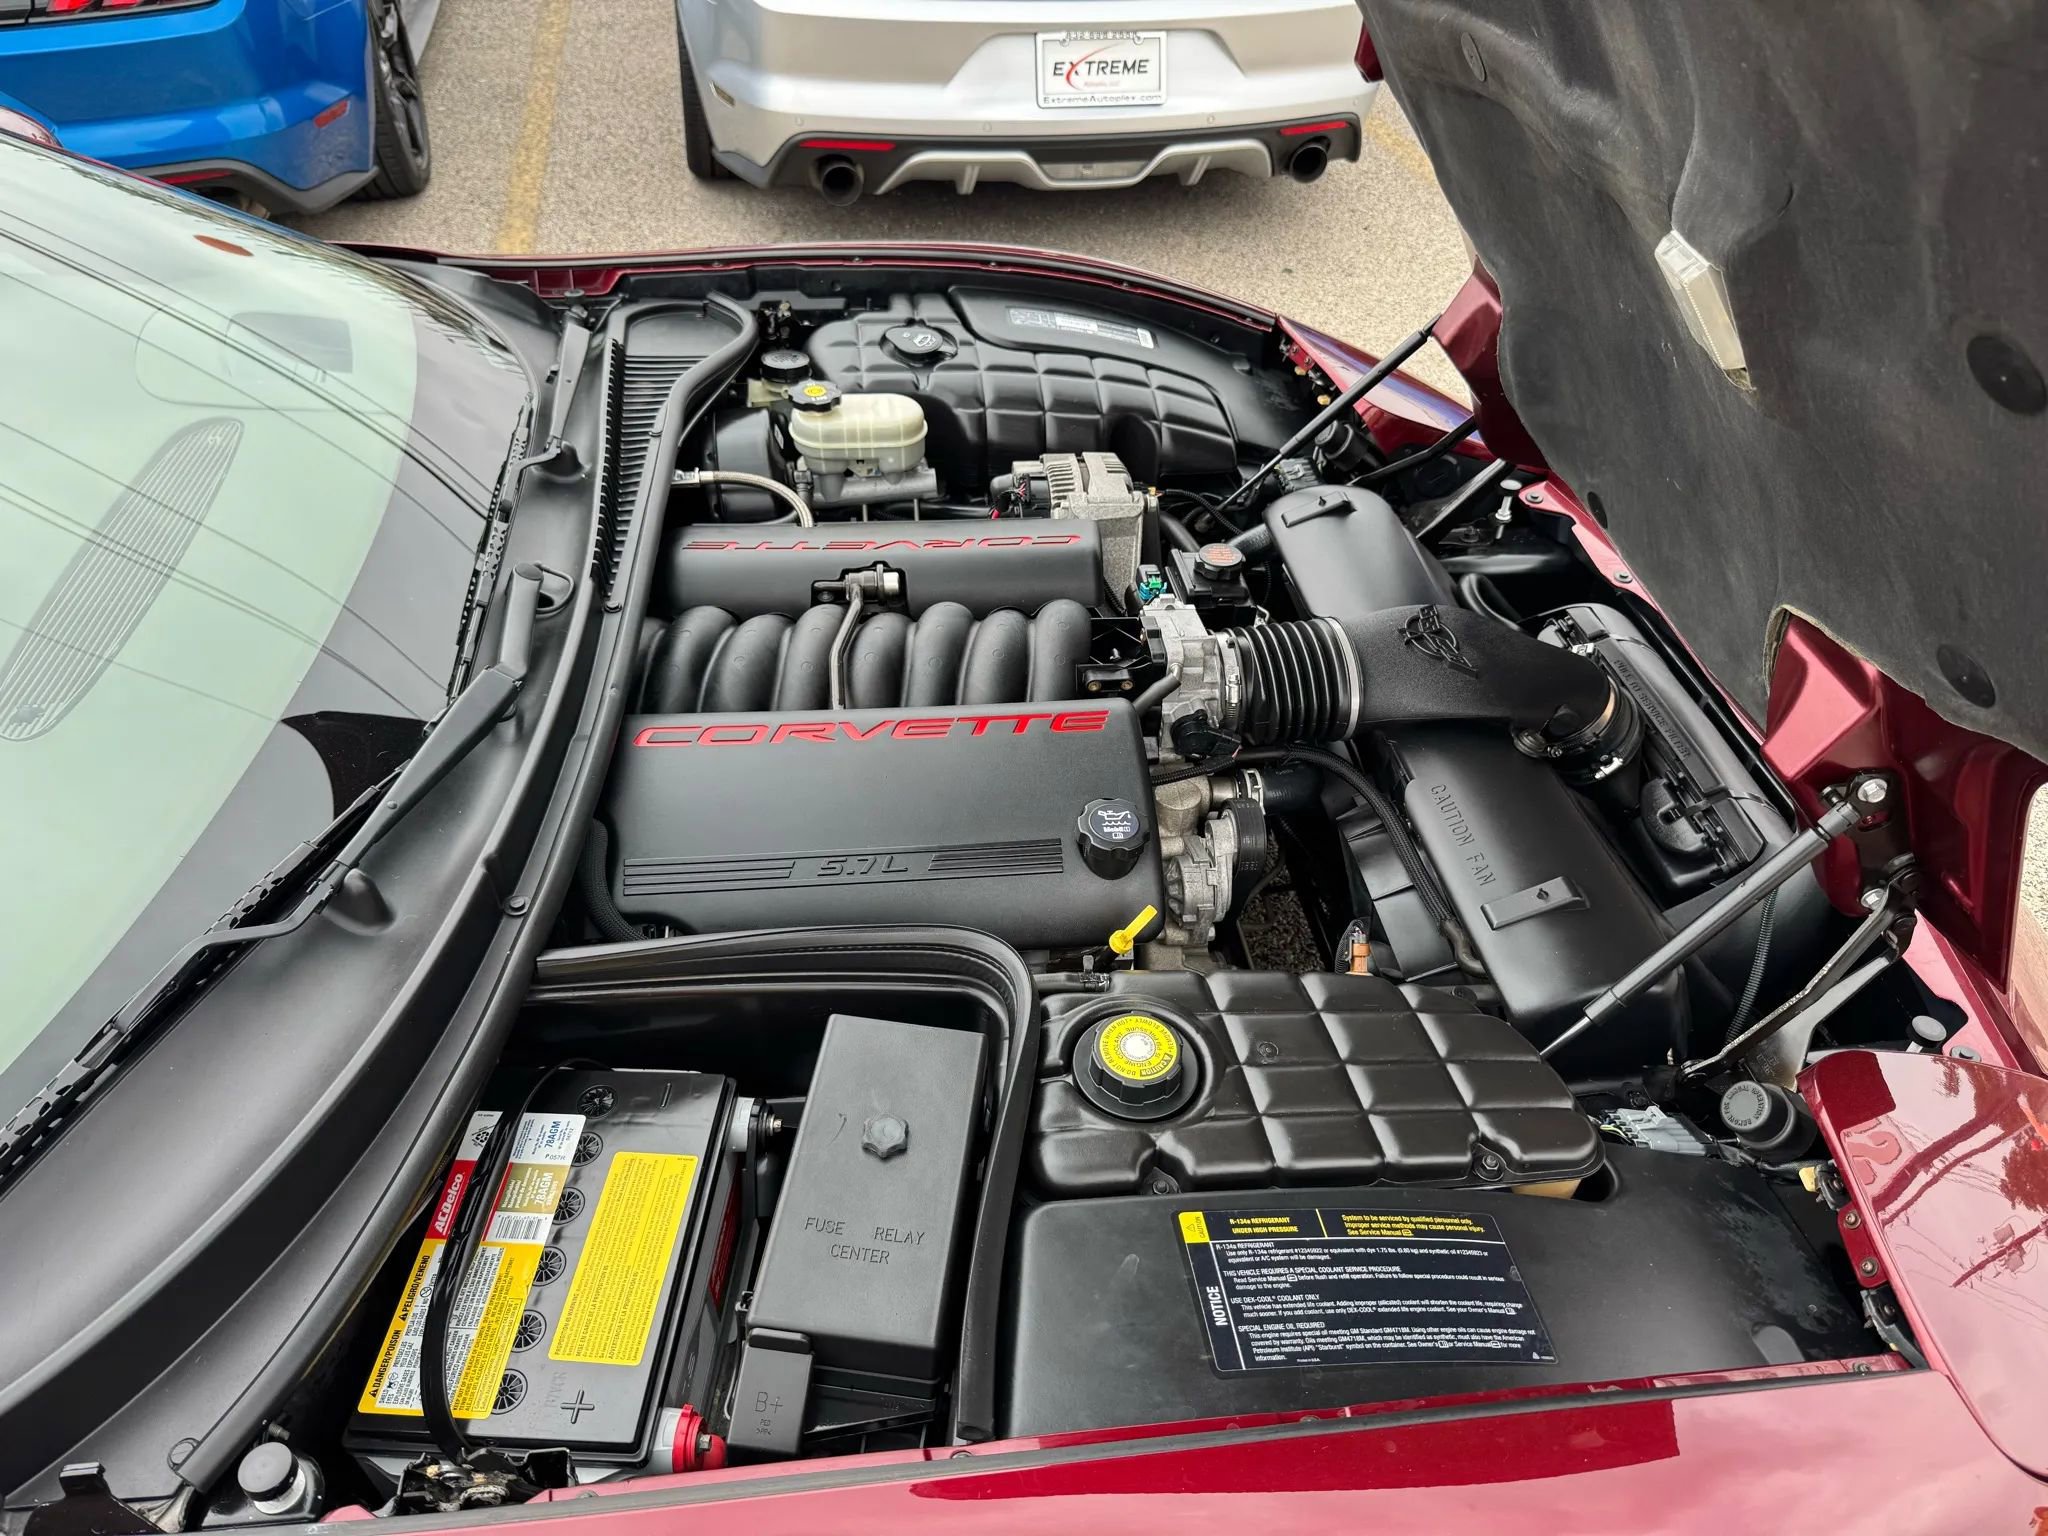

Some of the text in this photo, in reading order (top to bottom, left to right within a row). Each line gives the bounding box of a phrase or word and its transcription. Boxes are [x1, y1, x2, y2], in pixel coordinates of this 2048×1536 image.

[1053, 59, 1150, 76] EXTREME
[682, 534, 1081, 550] CORVETTE
[632, 709, 1110, 748] CORVETTE
[1430, 784, 1496, 886] CAUTION FAN
[817, 855, 908, 876] 5.7L
[544, 1120, 561, 1147] 78AGM
[533, 1172, 553, 1204] 78AGM
[432, 1172, 464, 1231] ACDelco
[804, 1217, 925, 1246] FUSE RELAY
[1195, 1216, 1206, 1239] CAUTION
[1445, 1224, 1468, 1232] personal
[830, 1244, 890, 1265] CENTER
[1228, 1256, 1254, 1264] equivalent
[1271, 1255, 1289, 1263] system
[1307, 1254, 1331, 1262] damaged.
[1223, 1269, 1236, 1277] THIS
[1236, 1268, 1261, 1276] VEHICLE
[1261, 1267, 1289, 1275] REQUIRES
[1206, 1286, 1228, 1326] NOTICE
[1230, 1296, 1242, 1304] USE
[372, 1255, 430, 1387] DANGER/POISON PELIGRO/VENENO
[1238, 1324, 1262, 1332] SPECIAL
[1296, 1321, 1325, 1329] REQUIRED
[1249, 1331, 1261, 1339] This
[1328, 1328, 1349, 1336] meeting
[755, 1391, 783, 1414] B+
